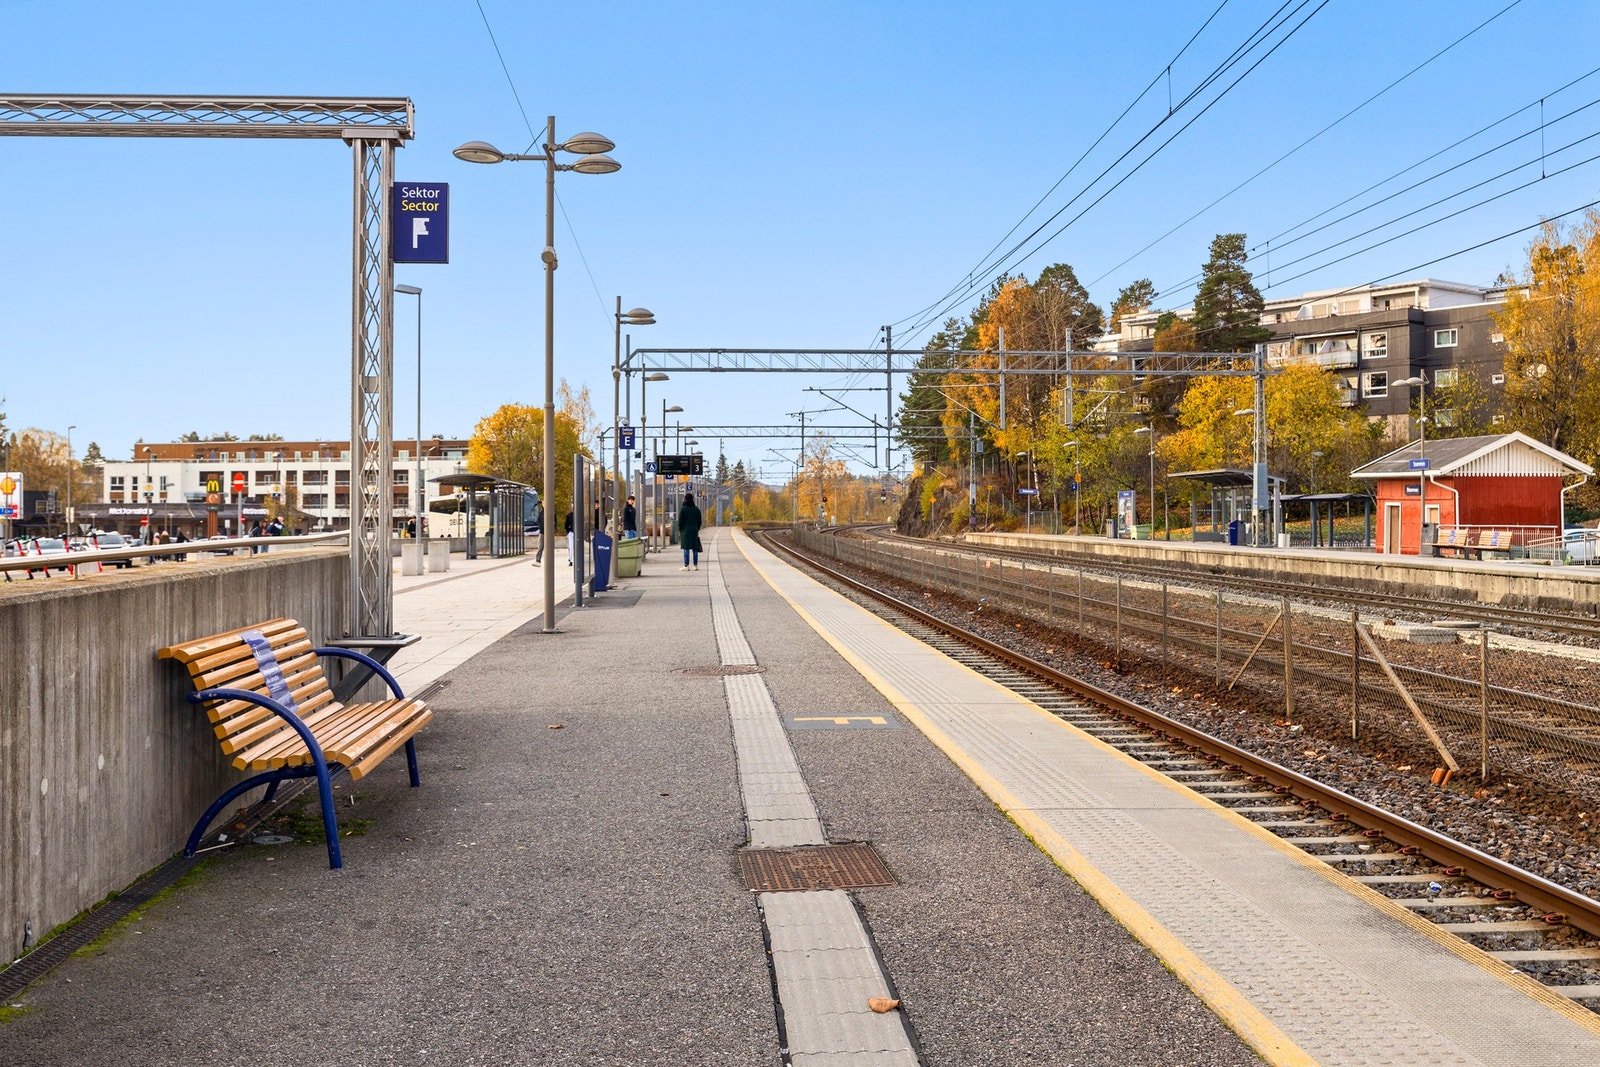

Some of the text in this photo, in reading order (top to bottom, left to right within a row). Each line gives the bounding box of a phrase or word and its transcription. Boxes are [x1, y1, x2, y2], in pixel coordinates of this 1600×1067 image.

[401, 186, 440, 198] Sektor
[401, 199, 439, 211] Sector
[412, 217, 430, 249] F
[624, 436, 631, 446] E
[695, 464, 700, 472] 3
[109, 507, 153, 515] McDonalds
